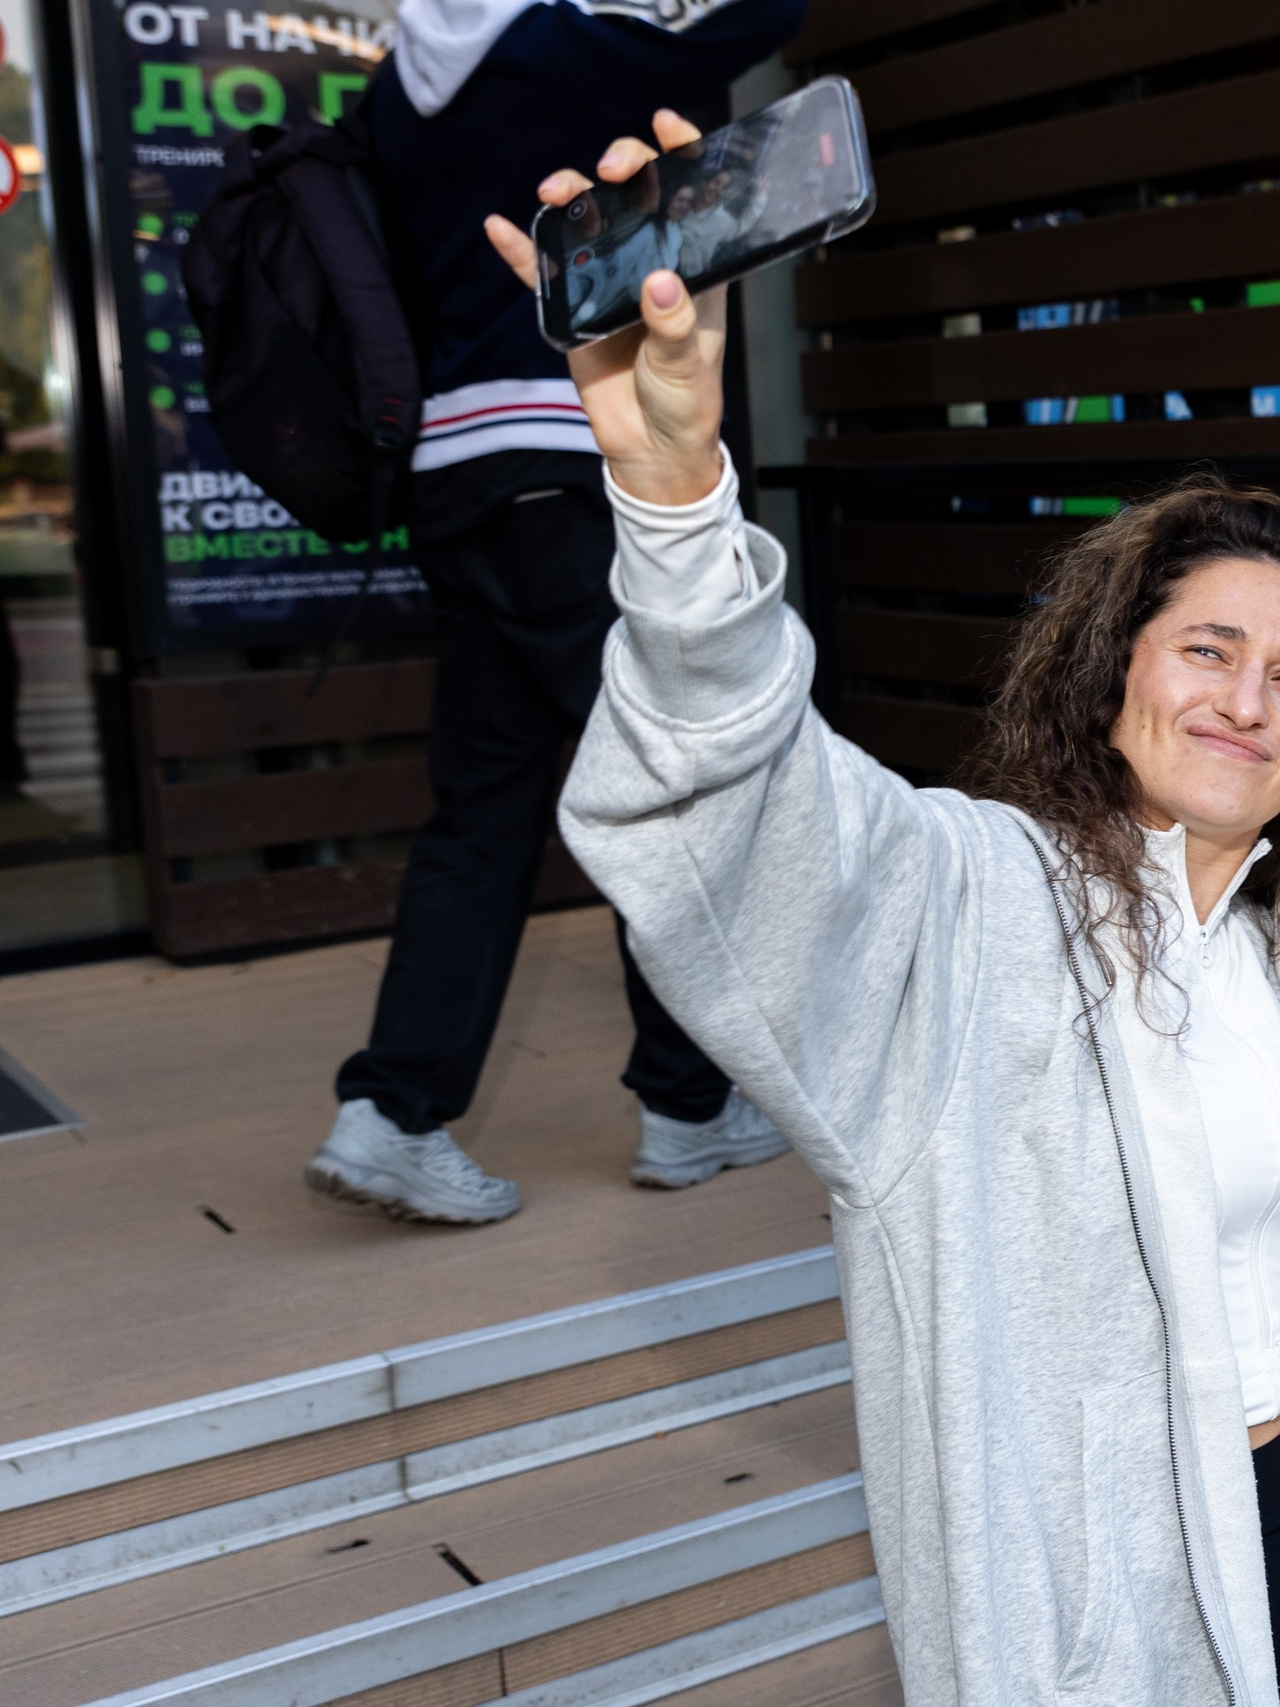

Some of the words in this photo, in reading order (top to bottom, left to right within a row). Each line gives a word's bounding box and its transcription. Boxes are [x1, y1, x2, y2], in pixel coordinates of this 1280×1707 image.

[124, 3, 209, 47] ОТ
[132, 61, 287, 138] ДО
[159, 470, 264, 503] ДВИ
[162, 504, 193, 532] К
[203, 500, 300, 530] СВО
